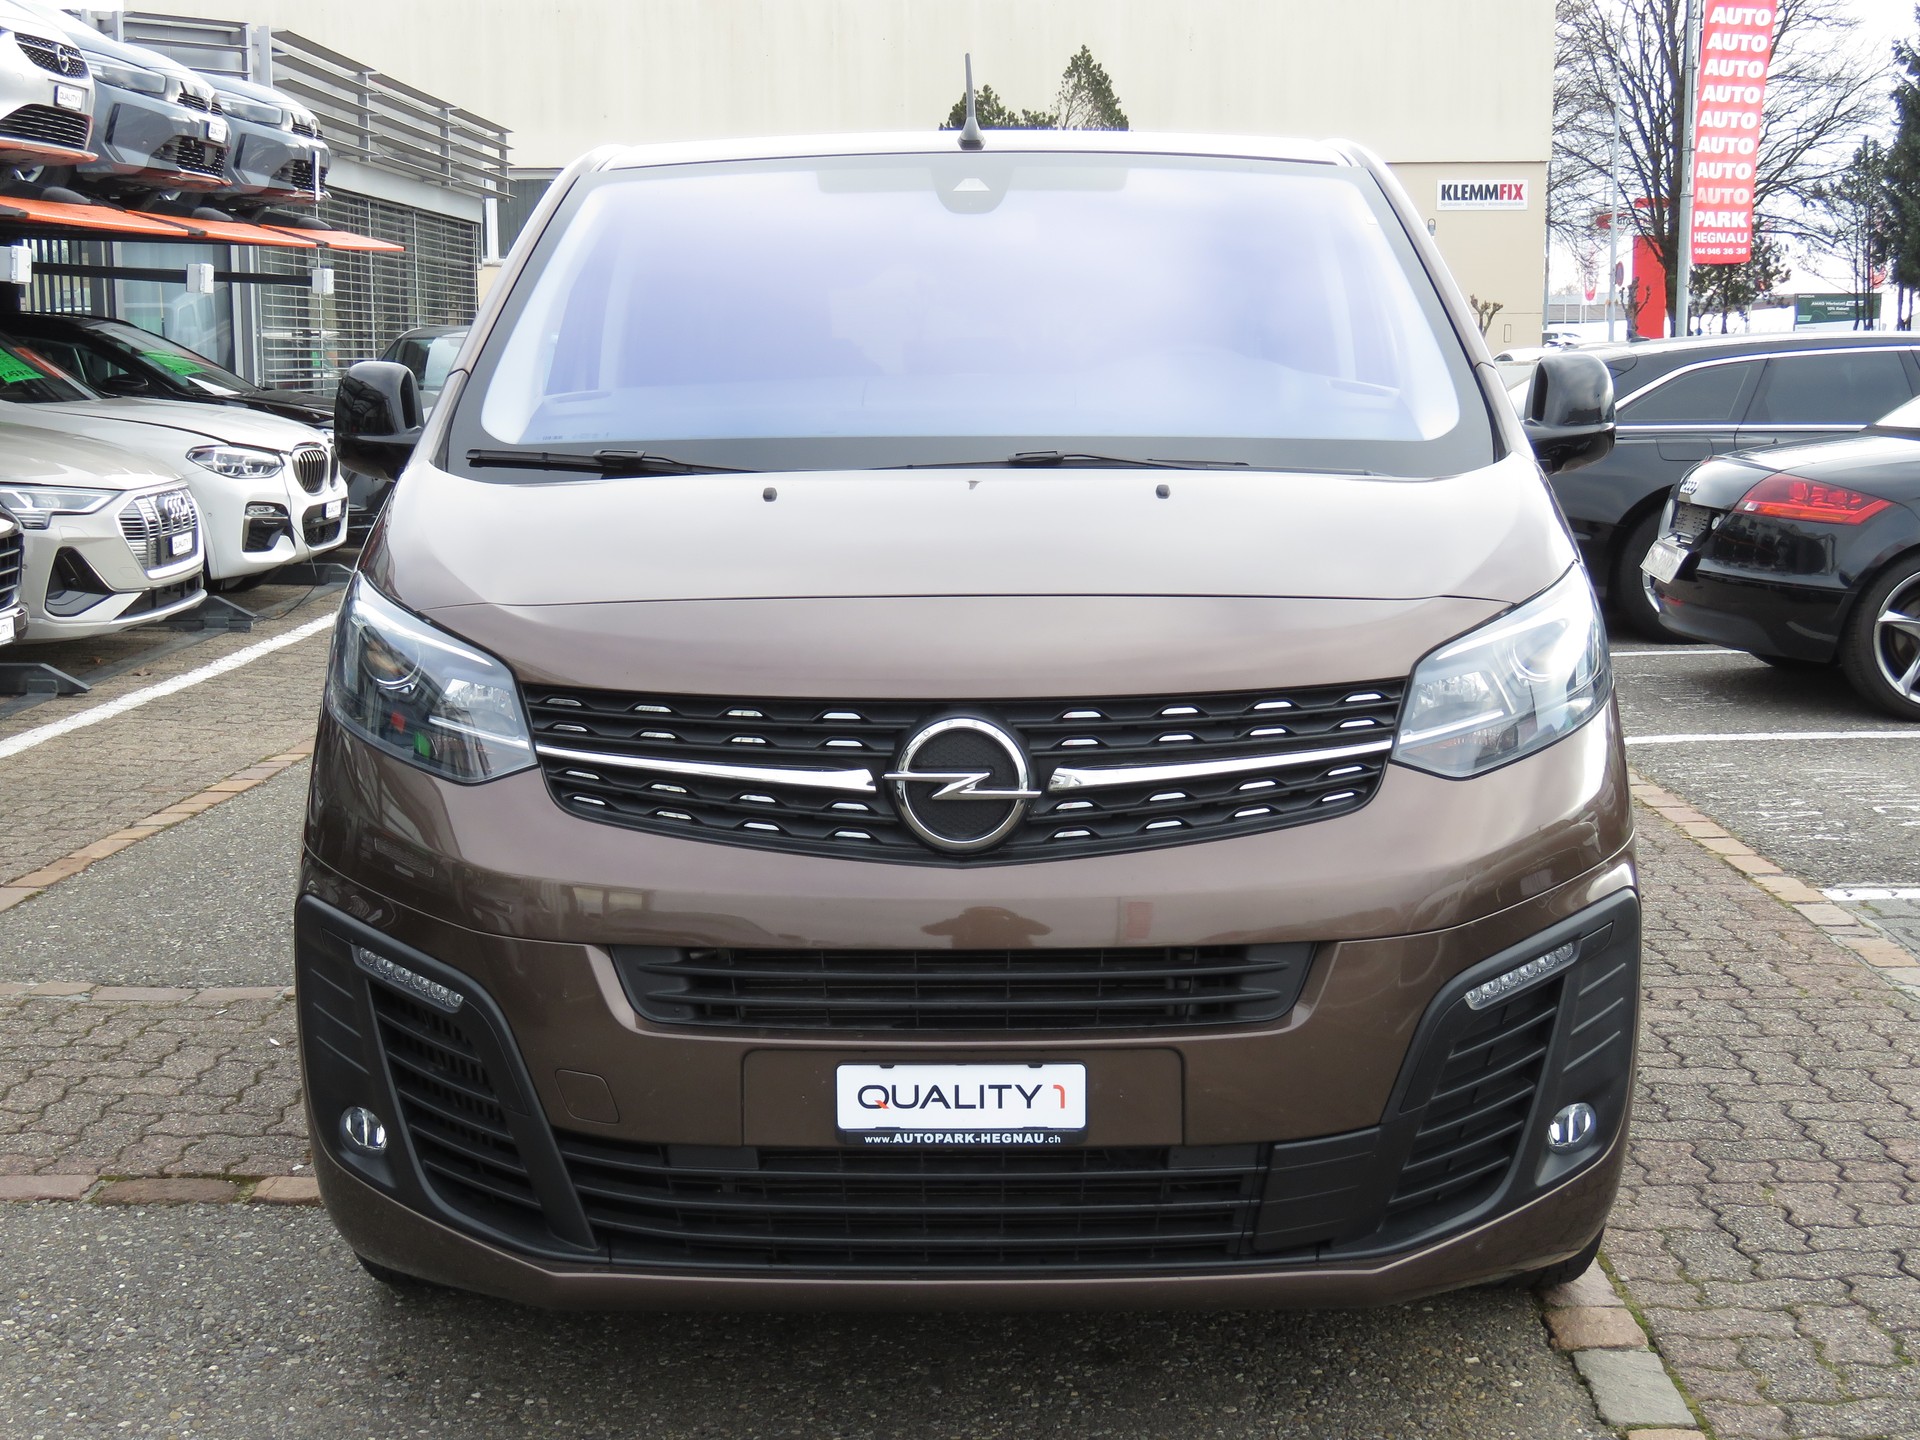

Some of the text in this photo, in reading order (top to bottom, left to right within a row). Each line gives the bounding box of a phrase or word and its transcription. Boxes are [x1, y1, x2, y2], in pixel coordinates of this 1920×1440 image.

[1709, 6, 1772, 27] AUTO
[1706, 32, 1768, 53] AUTO
[1703, 58, 1765, 79] AUTO
[1701, 84, 1761, 104] AUTO
[1698, 110, 1758, 130] AUTO
[1697, 136, 1754, 155] AUTO
[1696, 162, 1752, 180] AUTO
[1441, 183, 1524, 201] KLEMMFIX
[1696, 187, 1750, 205] AUTO
[1694, 211, 1748, 228] PARK
[1694, 232, 1748, 244] HEGNAU
[922, 720, 1002, 739] OPEL
[857, 1084, 1065, 1110] QUALITY 1
[864, 1133, 1061, 1144] www.AUTOPARK-HEGNAU.ch
